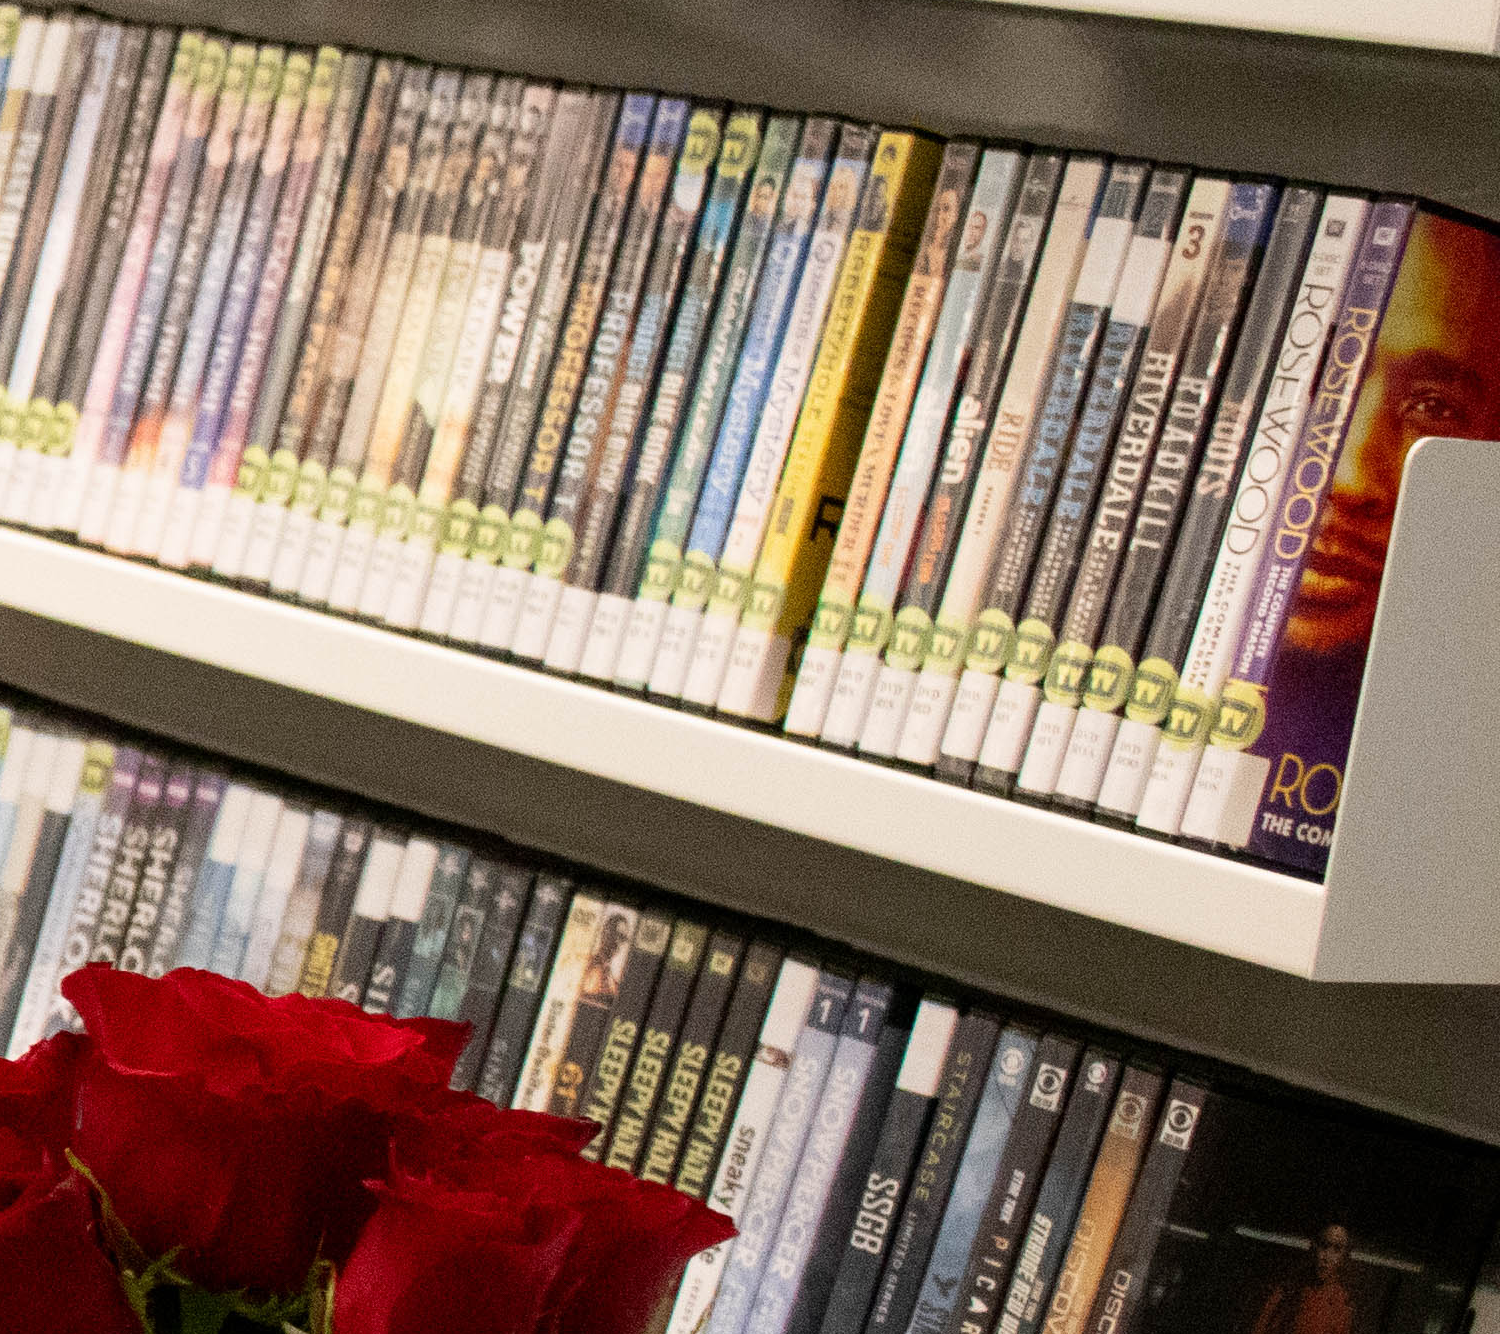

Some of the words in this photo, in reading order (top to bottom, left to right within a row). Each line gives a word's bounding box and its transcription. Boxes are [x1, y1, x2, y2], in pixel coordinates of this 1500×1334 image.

[942, 395, 987, 485] alien
[1092, 349, 1173, 550] RIVERDALE
[1131, 377, 1204, 550] ROADKILL
[1227, 282, 1333, 554] ROSEWOOD
[1275, 307, 1378, 560] ROSEWOOD
[1262, 812, 1293, 838] THE
[626, 1029, 670, 1116] SLEEPY
[661, 1040, 707, 1131] SLEEPY
[694, 1051, 742, 1143] SLEEPY
[714, 1124, 756, 1209] sneaky
[915, 1051, 972, 1201] STAIRCASE
[851, 1172, 899, 1255] SSGB
